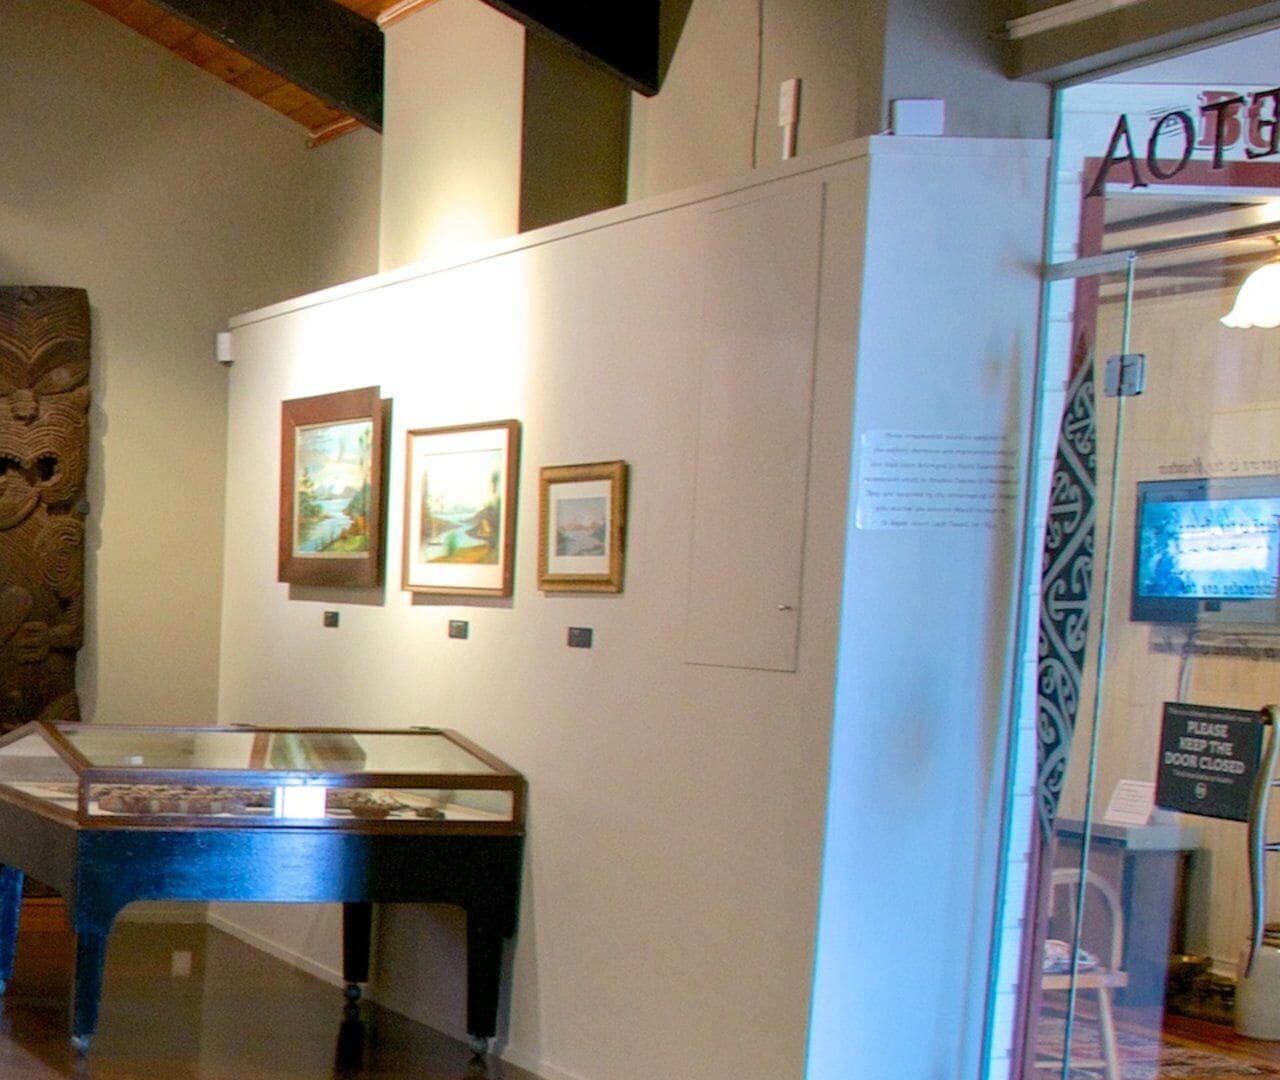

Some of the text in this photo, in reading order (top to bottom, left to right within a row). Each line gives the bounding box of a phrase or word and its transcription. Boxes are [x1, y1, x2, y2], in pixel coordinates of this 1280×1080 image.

[1186, 721, 1229, 738] PLEASE
[1180, 737, 1234, 756] KEEP THE
[1164, 751, 1245, 774] DOOR CLOSED
